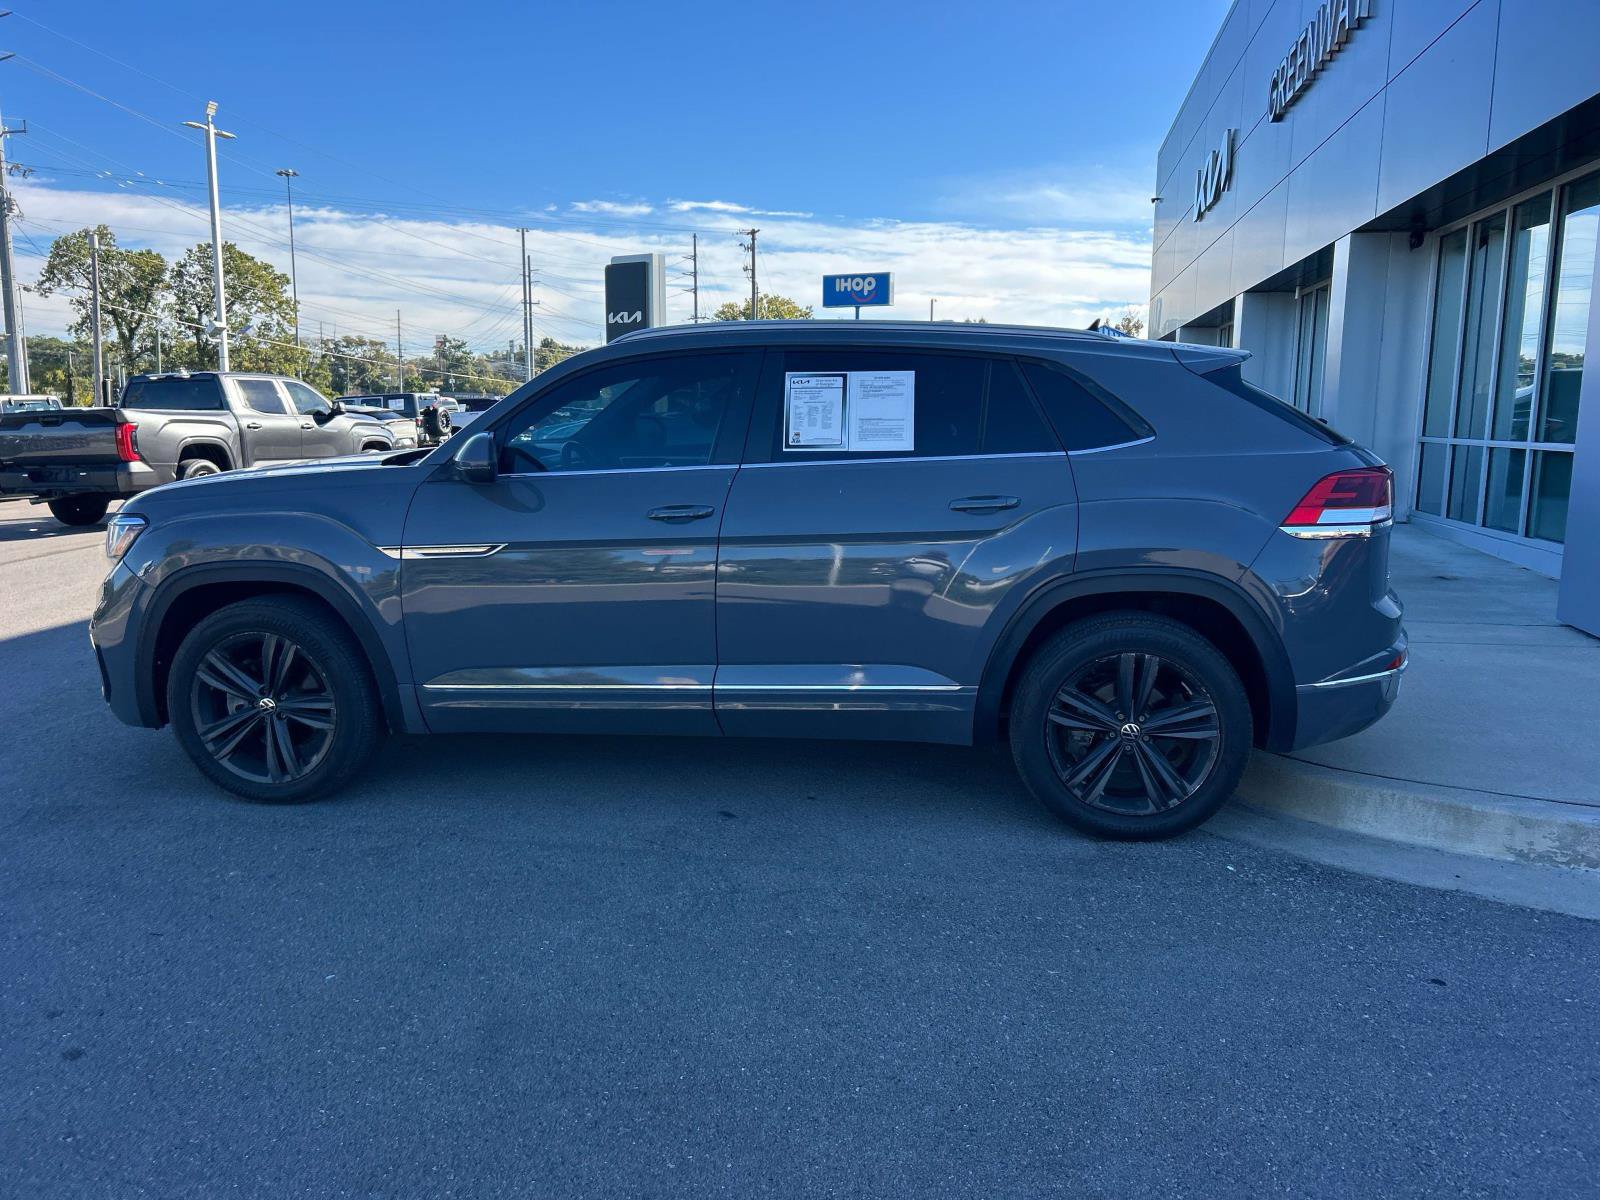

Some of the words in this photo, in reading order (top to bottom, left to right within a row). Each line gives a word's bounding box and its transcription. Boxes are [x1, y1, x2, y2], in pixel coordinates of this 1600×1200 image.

[1267, 0, 1370, 123] GREENWA
[1193, 128, 1235, 222] KIA
[835, 276, 877, 297] IHOP
[608, 310, 643, 324] KIA
